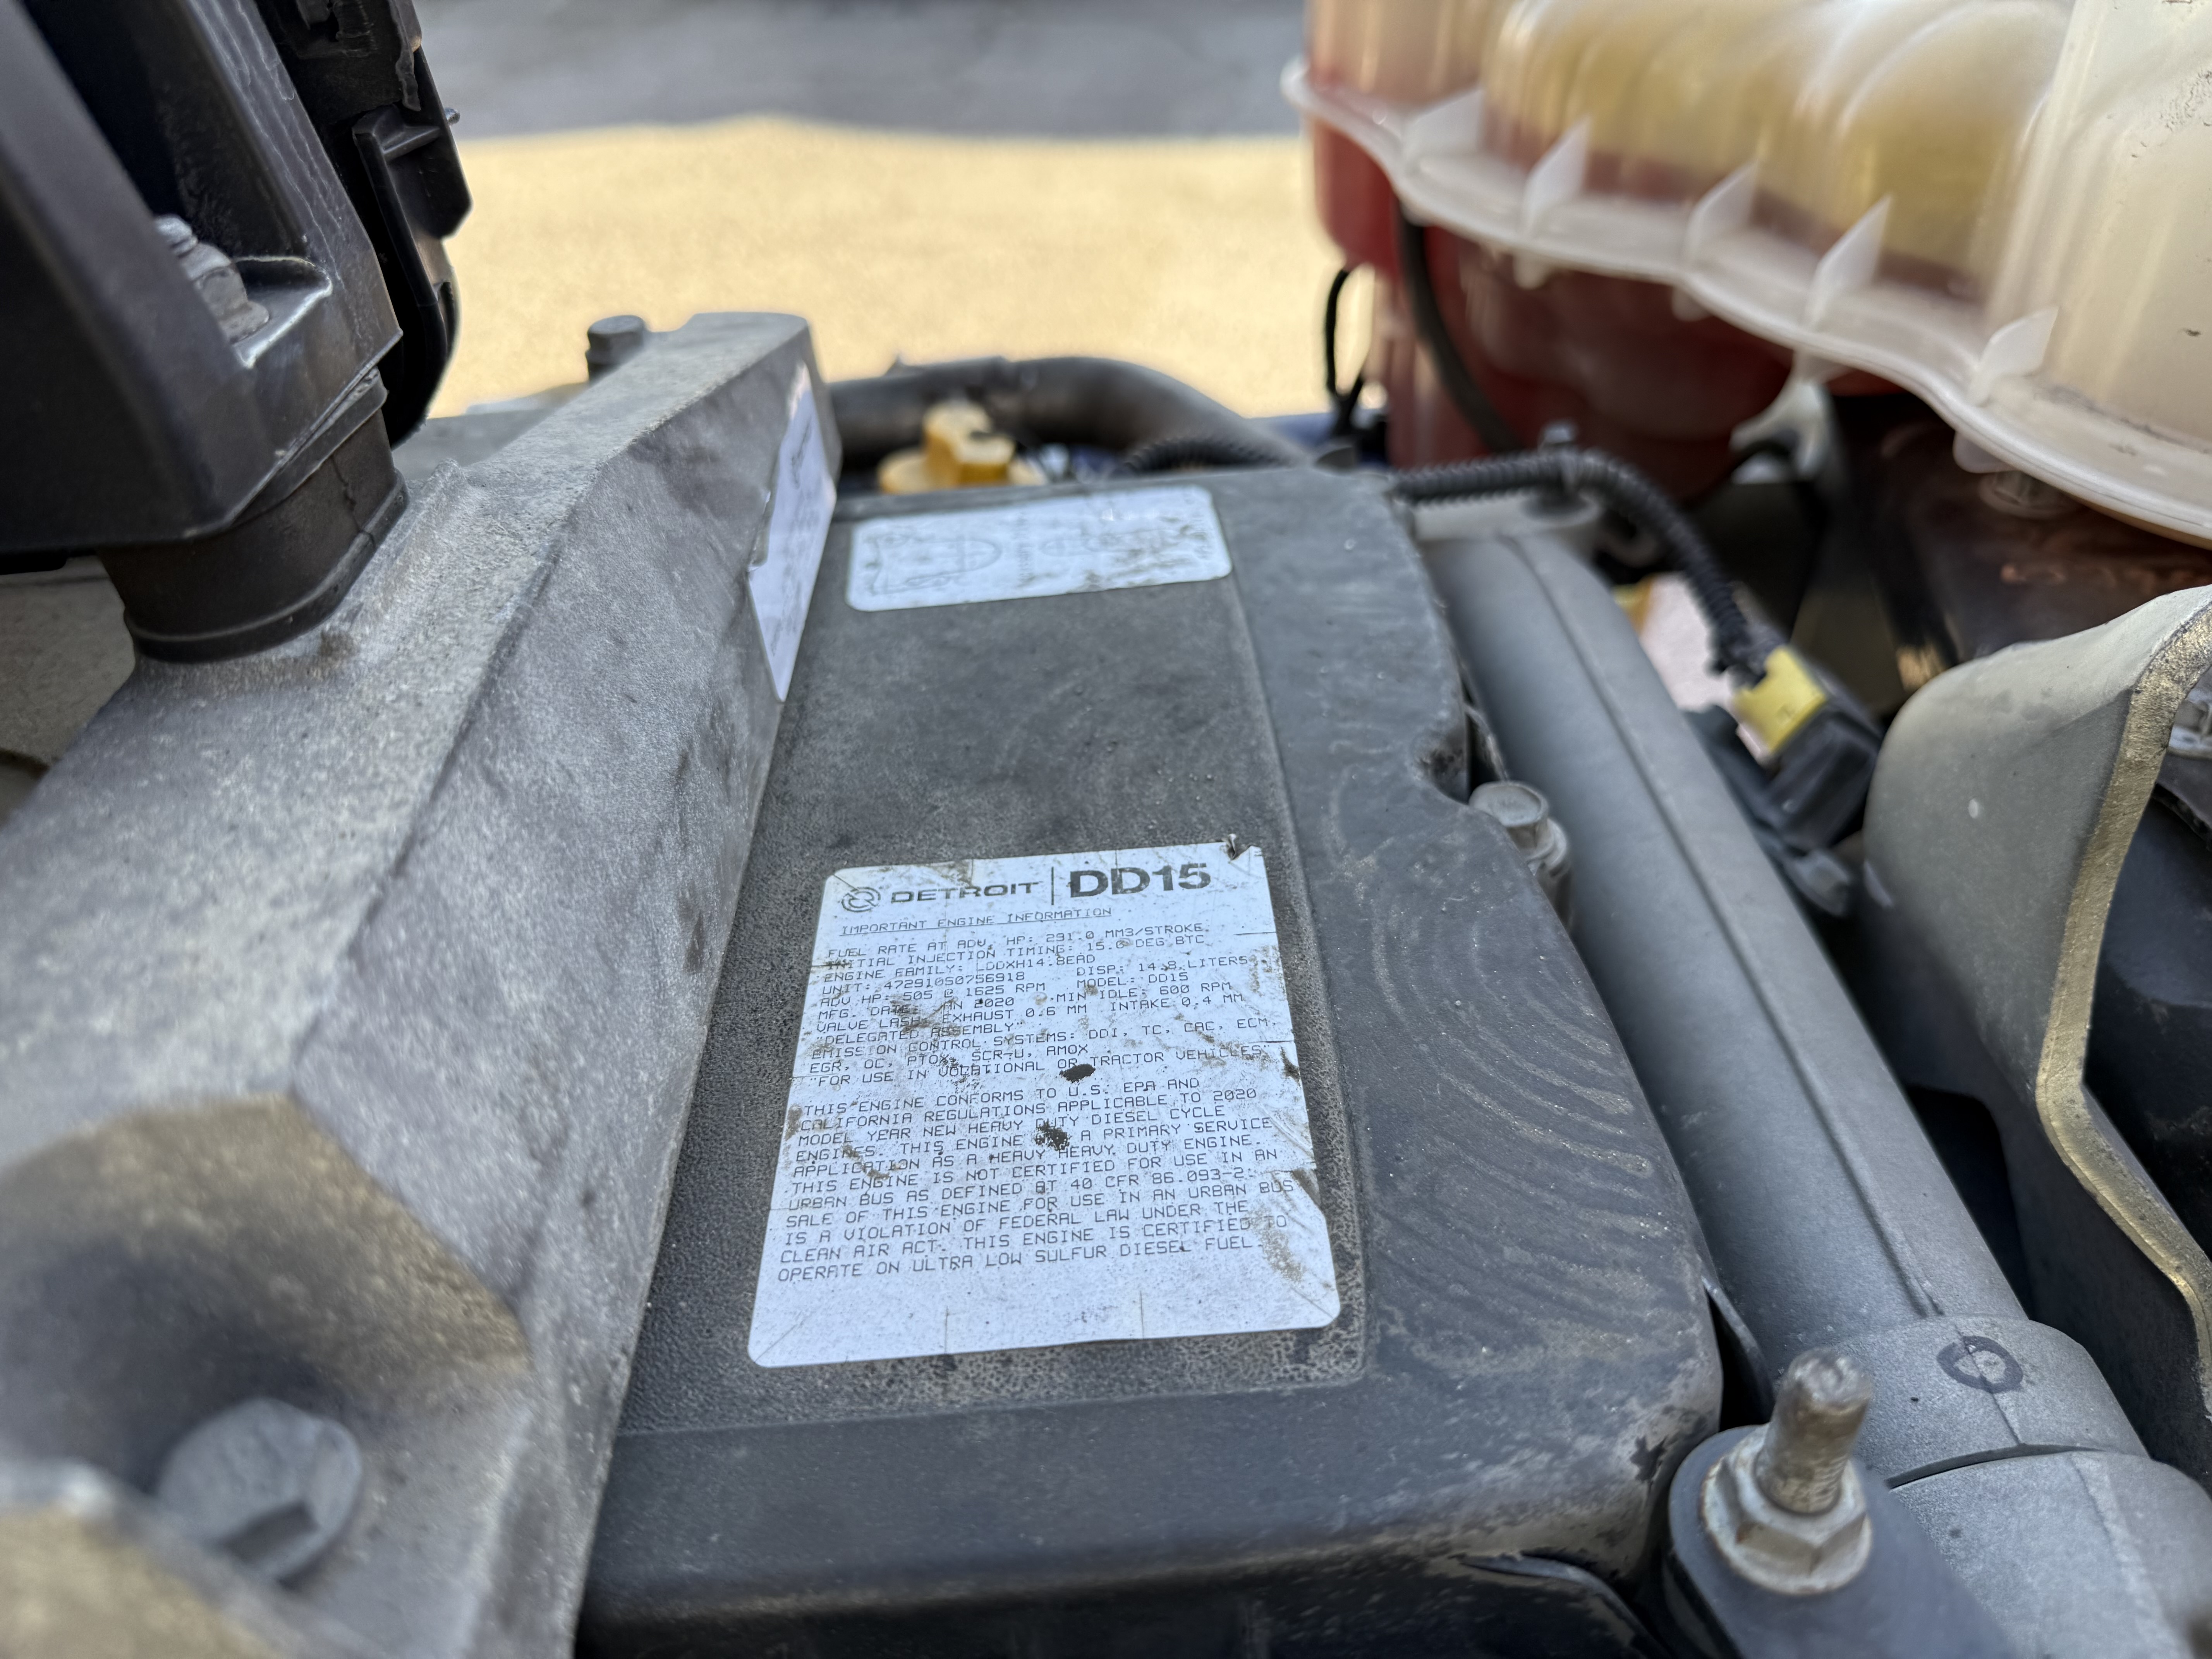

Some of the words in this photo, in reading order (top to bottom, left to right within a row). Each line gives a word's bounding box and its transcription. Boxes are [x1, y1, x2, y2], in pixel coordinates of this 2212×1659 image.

[891, 882, 1039, 903] DETROIT
[1070, 862, 1211, 898] DD15
[842, 920, 927, 934] IMPORTANT
[938, 915, 996, 928] ENGINE
[1008, 907, 1111, 922] INFORMATION
[828, 947, 867, 958] FUEL
[878, 943, 916, 954] RATE
[927, 941, 946, 951] AT
[957, 938, 993, 948] ADV.
[1046, 931, 1094, 942] 291.0
[1105, 923, 1203, 938] MM3/STROKE
[908, 950, 995, 964] INJECTION
[1006, 944, 1072, 957] TIMING:
[1087, 940, 1124, 951] 15.0
[1135, 937, 1164, 947] DEG
[1175, 934, 1204, 945] BTC
[824, 969, 884, 982] ENGINE
[895, 964, 962, 977] FAMILY:
[976, 954, 1095, 971] LDDXH14.8EAD
[1077, 964, 1123, 976] DISP:
[1188, 955, 1247, 968] LITERS
[1077, 975, 1134, 988] MODEL:
[1148, 972, 1188, 983] DD15
[821, 996, 850, 1007] ADV
[862, 993, 889, 1004] HP:
[903, 990, 932, 1001] 505
[944, 989, 953, 998] @
[966, 985, 1004, 996] 1625
[1016, 982, 1044, 993] RPM
[823, 982, 871, 994] UNIT:
[1057, 992, 1086, 1002] MIN
[1099, 987, 1146, 999] IDLE:
[1159, 984, 1189, 994] 600
[1200, 981, 1231, 992] RPM
[817, 1020, 868, 1032] VALVE
[942, 1009, 1013, 1023] EXHAUST
[1025, 1006, 1055, 1017] 0.6
[1067, 1004, 1086, 1014] MM
[1110, 998, 1170, 1011] INTAKE
[1181, 995, 1211, 1006] 0.4
[1223, 993, 1243, 1003] MM
[819, 1008, 856, 1019] MFG.
[974, 997, 1014, 1008] 2020
[812, 1044, 896, 1059] EMISSION
[908, 1038, 981, 1052] CONTROL
[993, 1031, 1074, 1046] SYSTEMS:
[1089, 1028, 1127, 1039] DDI,
[1142, 1025, 1170, 1035] TC,
[1184, 1021, 1223, 1032] CAC,
[1237, 1017, 1276, 1029] ECM,
[816, 1029, 919, 1045] "DELEGATED
[931, 1022, 1022, 1037] ASSEMBLY"
[810, 1061, 849, 1073] EGR,
[864, 1058, 892, 1069] OC,
[972, 1048, 1032, 1061] SCR-U,
[1047, 1044, 1088, 1056] AMOX
[810, 1075, 850, 1086] "FOR
[862, 1071, 893, 1083] USE
[907, 1069, 926, 1080] IN
[938, 1060, 1045, 1077] VOCATIONAL
[1057, 1058, 1077, 1069] OR
[1089, 1052, 1164, 1066] TRACTOR
[1176, 1044, 1270, 1060] VEHICLES"
[801, 1113, 912, 1131] CALIFORNIA
[924, 1103, 1045, 1122] REGULATIONS
[1058, 1094, 1167, 1112] APPLICABLE
[1180, 1092, 1201, 1103] TO
[1213, 1088, 1257, 1101] 2020
[804, 1103, 847, 1116] THIS
[859, 1097, 924, 1112] ENGINE
[936, 1090, 1023, 1106] CONFORMS
[1036, 1087, 1056, 1099] TO
[1123, 1080, 1155, 1092] EPA
[1167, 1078, 1199, 1089] AND
[799, 1132, 854, 1146] MODEL
[866, 1128, 910, 1141] YEAR
[923, 1124, 955, 1137] NEW
[968, 1120, 1022, 1133] HEAVY
[1036, 1116, 1079, 1129] DUTY
[1091, 1110, 1157, 1125] DIESEL
[1170, 1105, 1224, 1119] CYCLE
[899, 1140, 943, 1154] THIS
[956, 1135, 1022, 1150] ENGINE
[1081, 1130, 1090, 1141] A
[1103, 1123, 1181, 1139] PRIMARY
[1194, 1117, 1272, 1133] SERVICE
[792, 1180, 837, 1194] THIS
[850, 1174, 918, 1190] ENGINE
[933, 1171, 953, 1184] IS
[966, 1168, 999, 1181] NOT
[1012, 1159, 1115, 1178] CERTIFIED
[1128, 1156, 1161, 1170] FOR
[1174, 1153, 1207, 1166] USE
[1221, 1151, 1242, 1163] IN
[1254, 1148, 1277, 1161] AN
[794, 1158, 919, 1178] APPLICATION
[932, 1155, 954, 1168] AS
[967, 1154, 977, 1165] A
[990, 1149, 1045, 1163] HEAVY
[1059, 1144, 1114, 1158] HEAVY
[1127, 1140, 1171, 1153] DUTY
[1184, 1134, 1261, 1149] ENGINE.
[786, 1213, 833, 1228] SALE
[845, 1210, 868, 1223] OF
[881, 1206, 927, 1221] THIS
[941, 1200, 1010, 1216] ENGINE
[1024, 1197, 1057, 1210] FOR
[1071, 1193, 1104, 1207] USE
[1119, 1191, 1140, 1203] IN
[1153, 1188, 1175, 1201] AN
[1188, 1183, 1246, 1198] URBAN
[1259, 1180, 1294, 1194] BUS
[789, 1195, 847, 1210] URBAN
[859, 1192, 893, 1206] BUS
[906, 1189, 928, 1202] AS
[941, 1182, 1022, 1199] DEFINED
[1036, 1180, 1057, 1193] AT
[1070, 1177, 1092, 1190] 40
[1105, 1174, 1139, 1188] CFR
[781, 1247, 840, 1263] CLEAN
[853, 1243, 888, 1258] AIR
[902, 1240, 945, 1254] ACT.
[963, 1234, 1009, 1250] THIS
[1023, 1228, 1094, 1245] ENGINE
[1109, 1225, 1130, 1239] IS
[1143, 1217, 1250, 1237] CERTIFIED
[1263, 1215, 1287, 1228] TO
[785, 1231, 807, 1245] IS
[820, 1230, 831, 1243] A
[844, 1221, 950, 1241] VIOLATION
[964, 1218, 986, 1232] OF
[1000, 1212, 1081, 1230] FEDERAL
[1095, 1208, 1129, 1223] LAW
[1142, 1203, 1200, 1219] UNDER
[1214, 1200, 1249, 1214] THE
[778, 1263, 863, 1281] OPERATE
[876, 1261, 900, 1274] ON
[913, 1255, 972, 1272] ULTRA
[986, 1252, 1021, 1266] LOW
[1036, 1245, 1106, 1263] SULFUR
[1120, 1239, 1192, 1257] DIESEL
[1205, 1235, 1262, 1250] FUEL.
